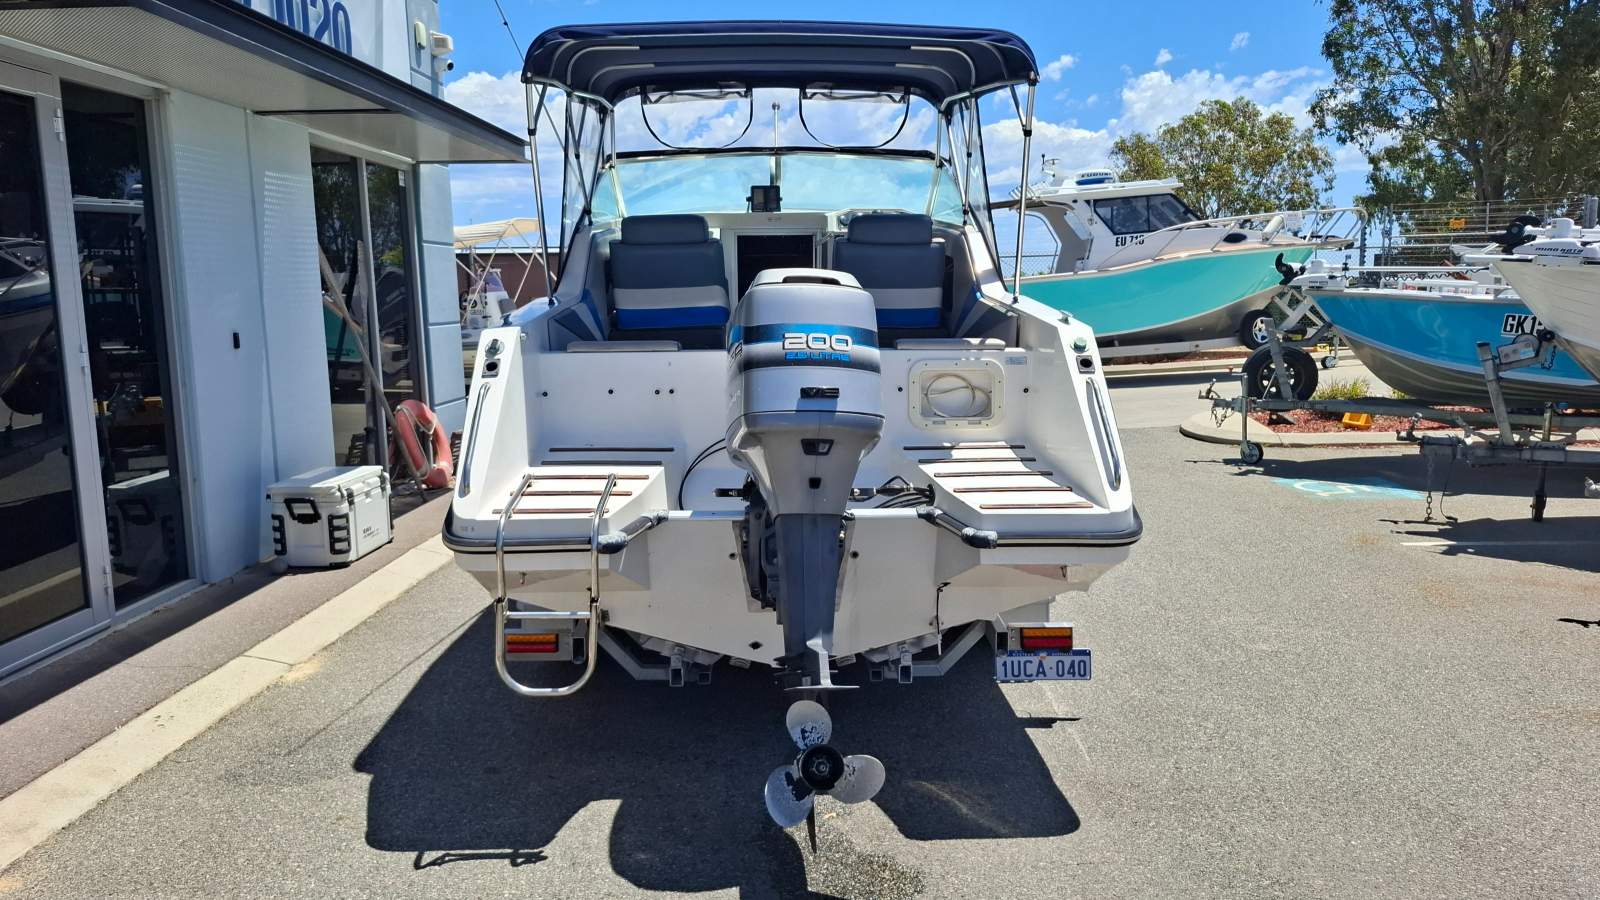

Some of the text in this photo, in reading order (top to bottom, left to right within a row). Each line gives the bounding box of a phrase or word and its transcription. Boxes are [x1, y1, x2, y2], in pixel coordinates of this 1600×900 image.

[1115, 236, 1127, 247] EU
[1503, 314, 1543, 335] GK1
[784, 333, 852, 351] 200
